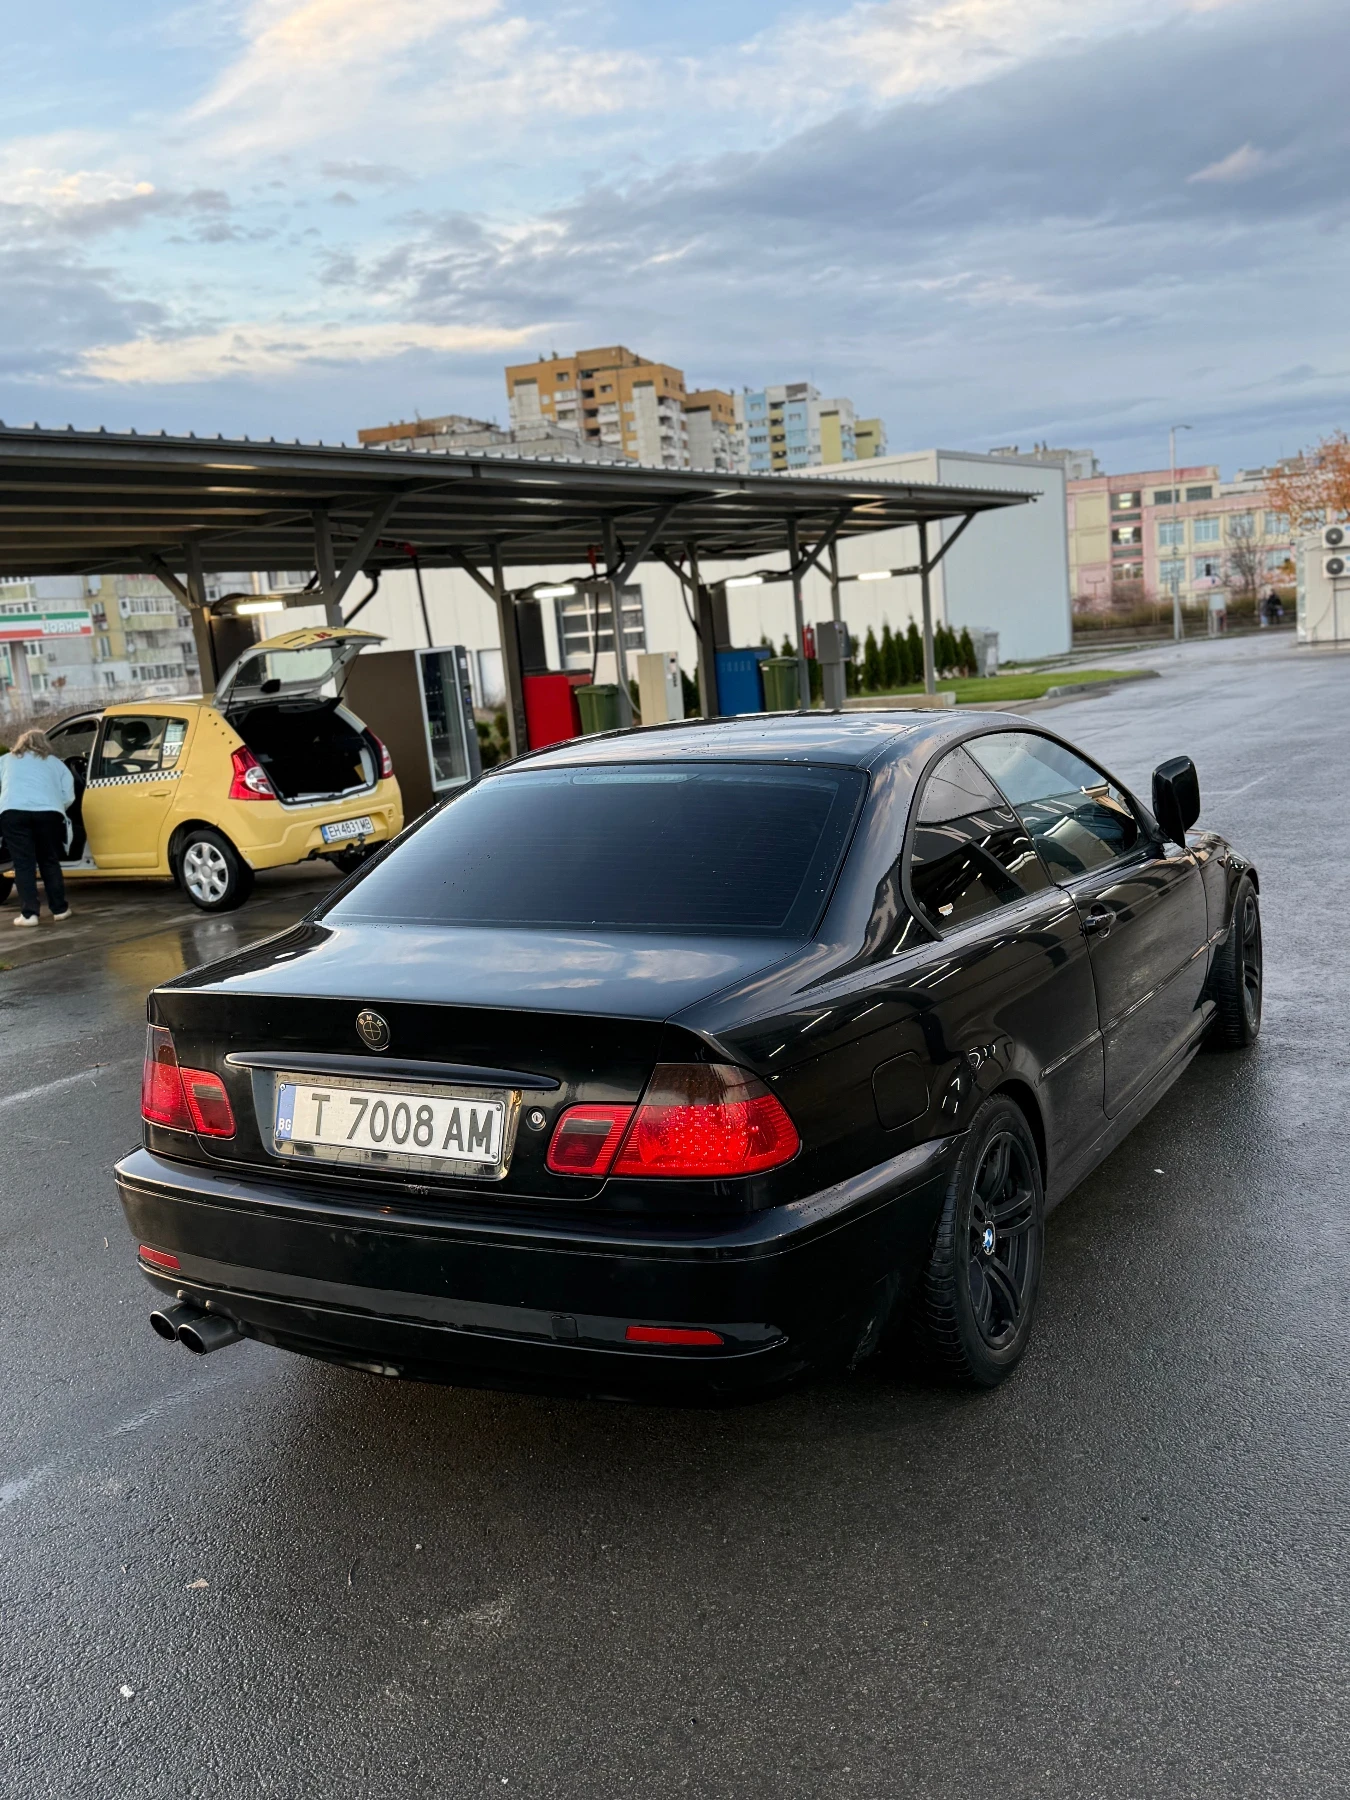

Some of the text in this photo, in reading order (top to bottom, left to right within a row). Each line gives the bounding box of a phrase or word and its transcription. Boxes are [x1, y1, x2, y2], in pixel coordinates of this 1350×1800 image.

[328, 825, 341, 838] EH
[341, 821, 361, 834] 4831
[358, 1014, 384, 1027] BMW
[278, 1117, 292, 1131] BG
[311, 1093, 494, 1154] T 7008 AM
